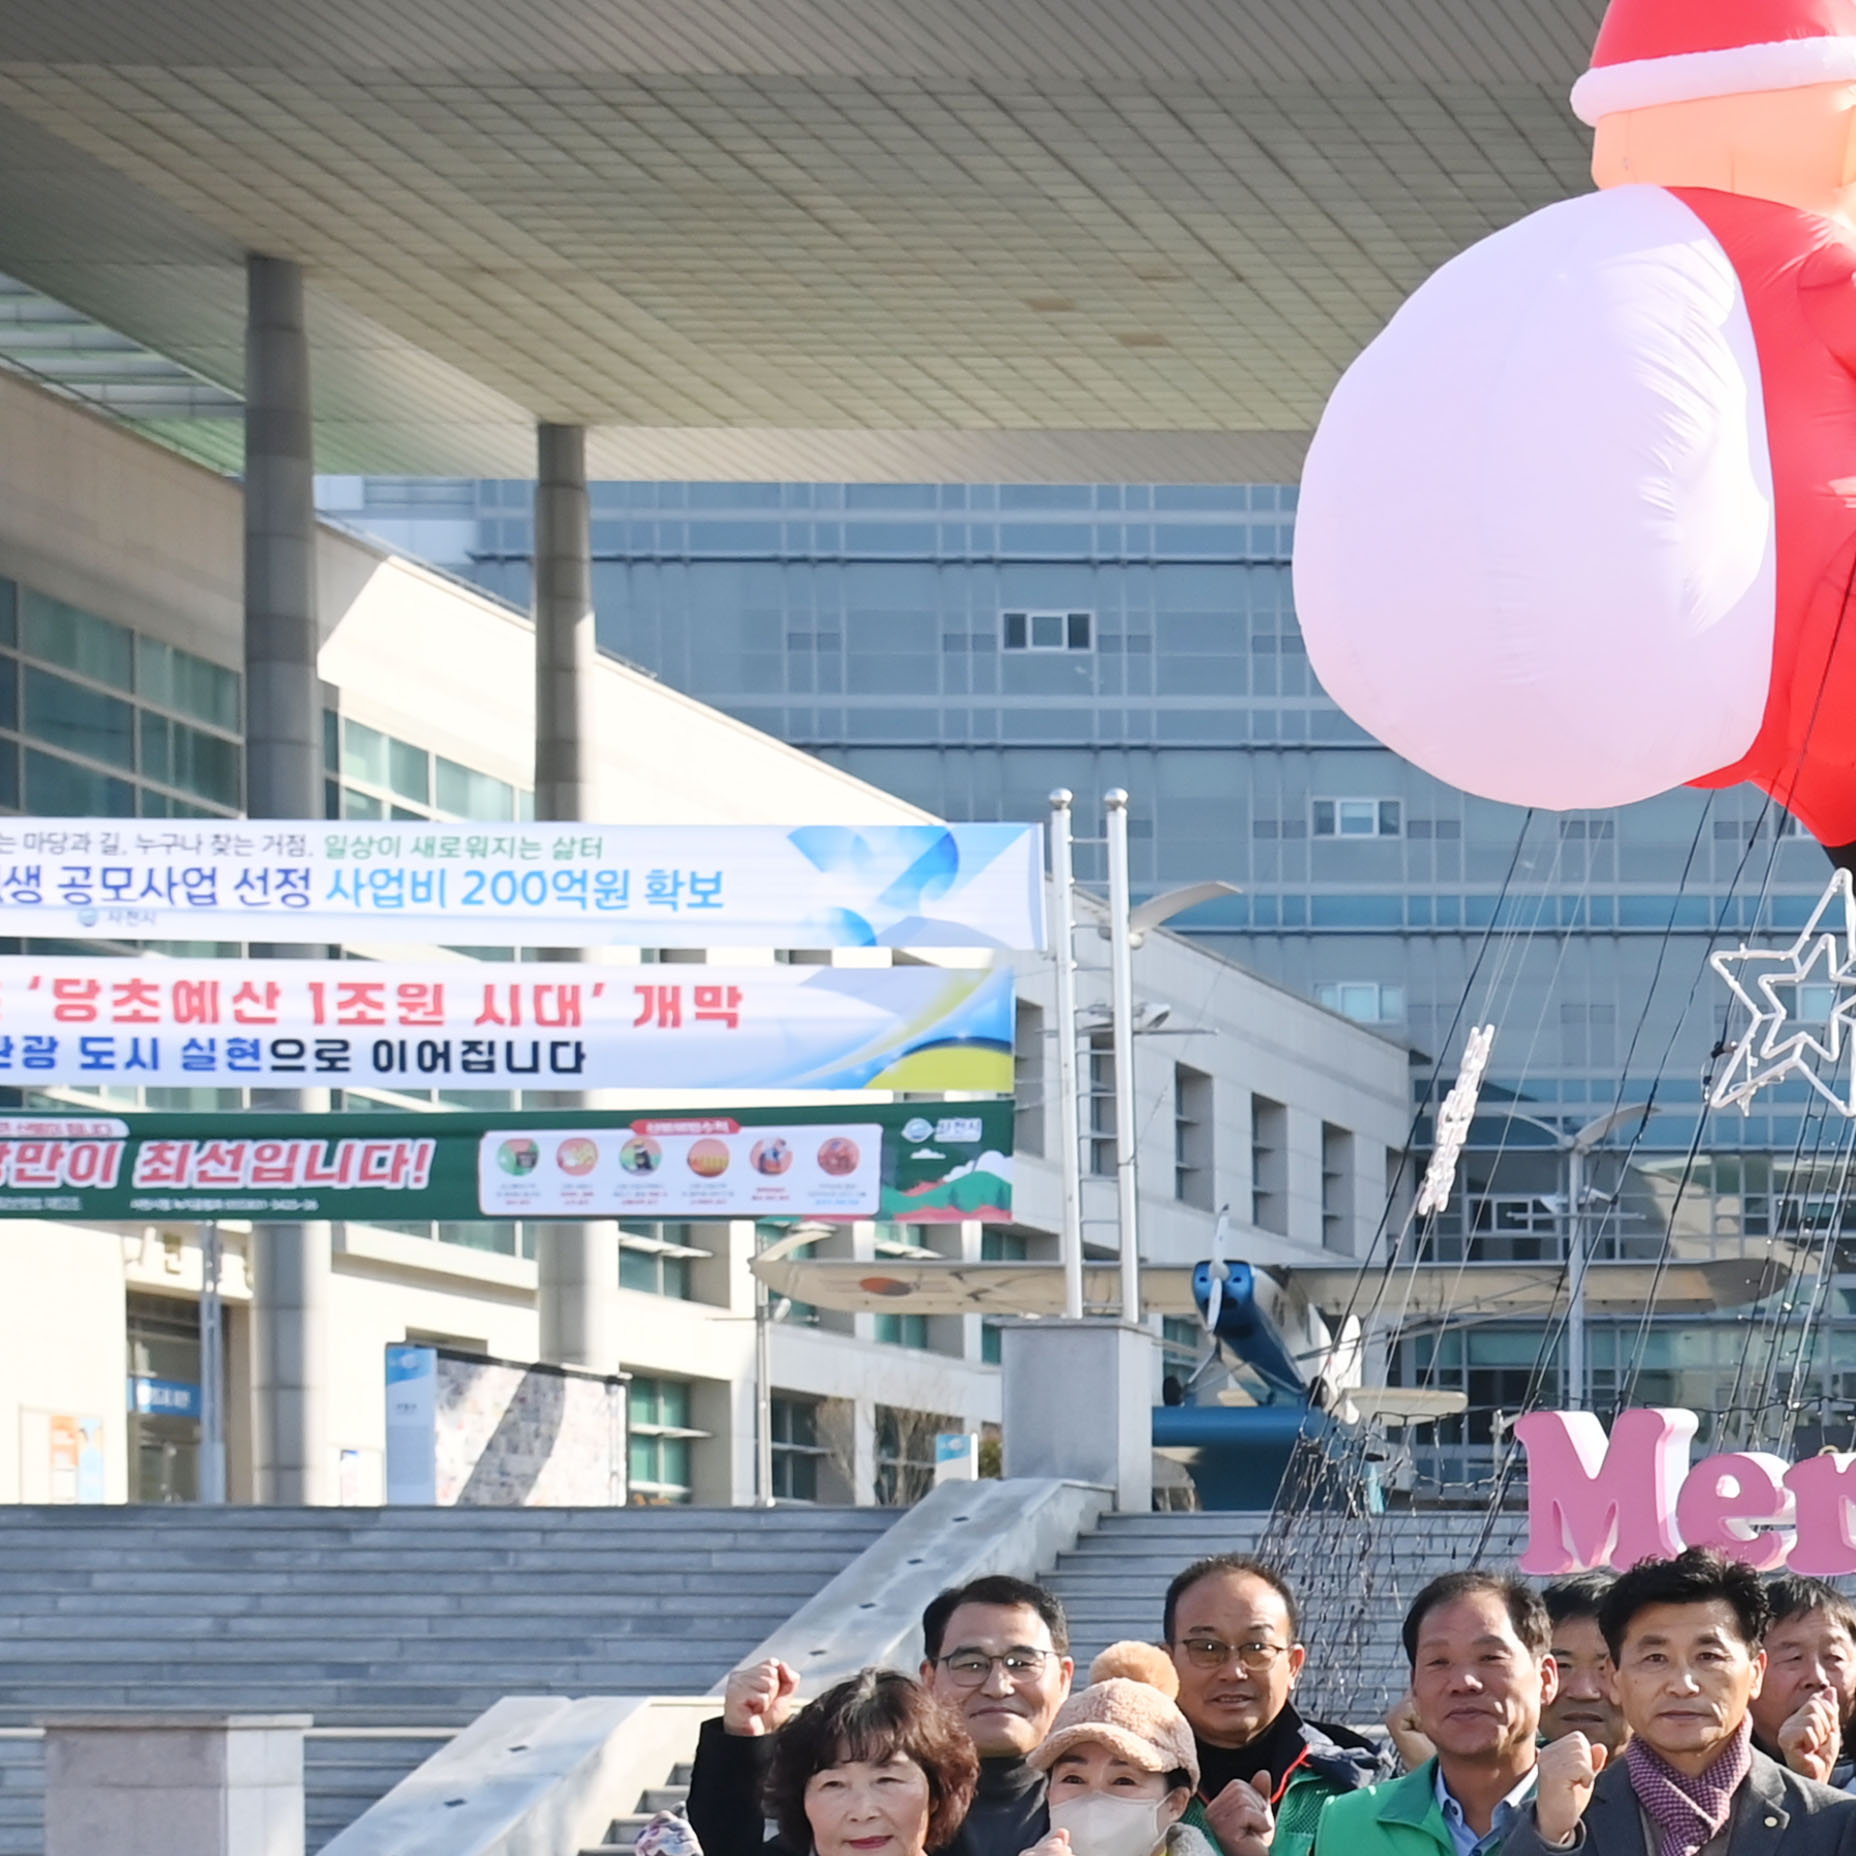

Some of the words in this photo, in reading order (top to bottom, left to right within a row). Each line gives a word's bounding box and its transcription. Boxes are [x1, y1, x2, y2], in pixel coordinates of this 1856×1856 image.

[23, 831, 91, 855] 마당과
[136, 833, 202, 856] 누구나
[211, 834, 253, 857] 찾는
[324, 835, 402, 859] 일상이
[411, 835, 543, 860] 새로워지는
[0, 864, 43, 904] 생
[57, 865, 218, 907] 공모사업
[234, 866, 311, 908] 선정
[326, 867, 447, 908] 사업비
[461, 868, 630, 911] 200억원
[644, 868, 725, 912] 확보
[308, 981, 446, 1027] 1조원
[633, 984, 743, 1029] 개막
[79, 1036, 160, 1072] 도시
[181, 1037, 351, 1073] 실현으로
[372, 1038, 587, 1075] 이어집니다
[0, 1141, 121, 1186] 만이
[135, 1141, 433, 1187] 최선입니다!
